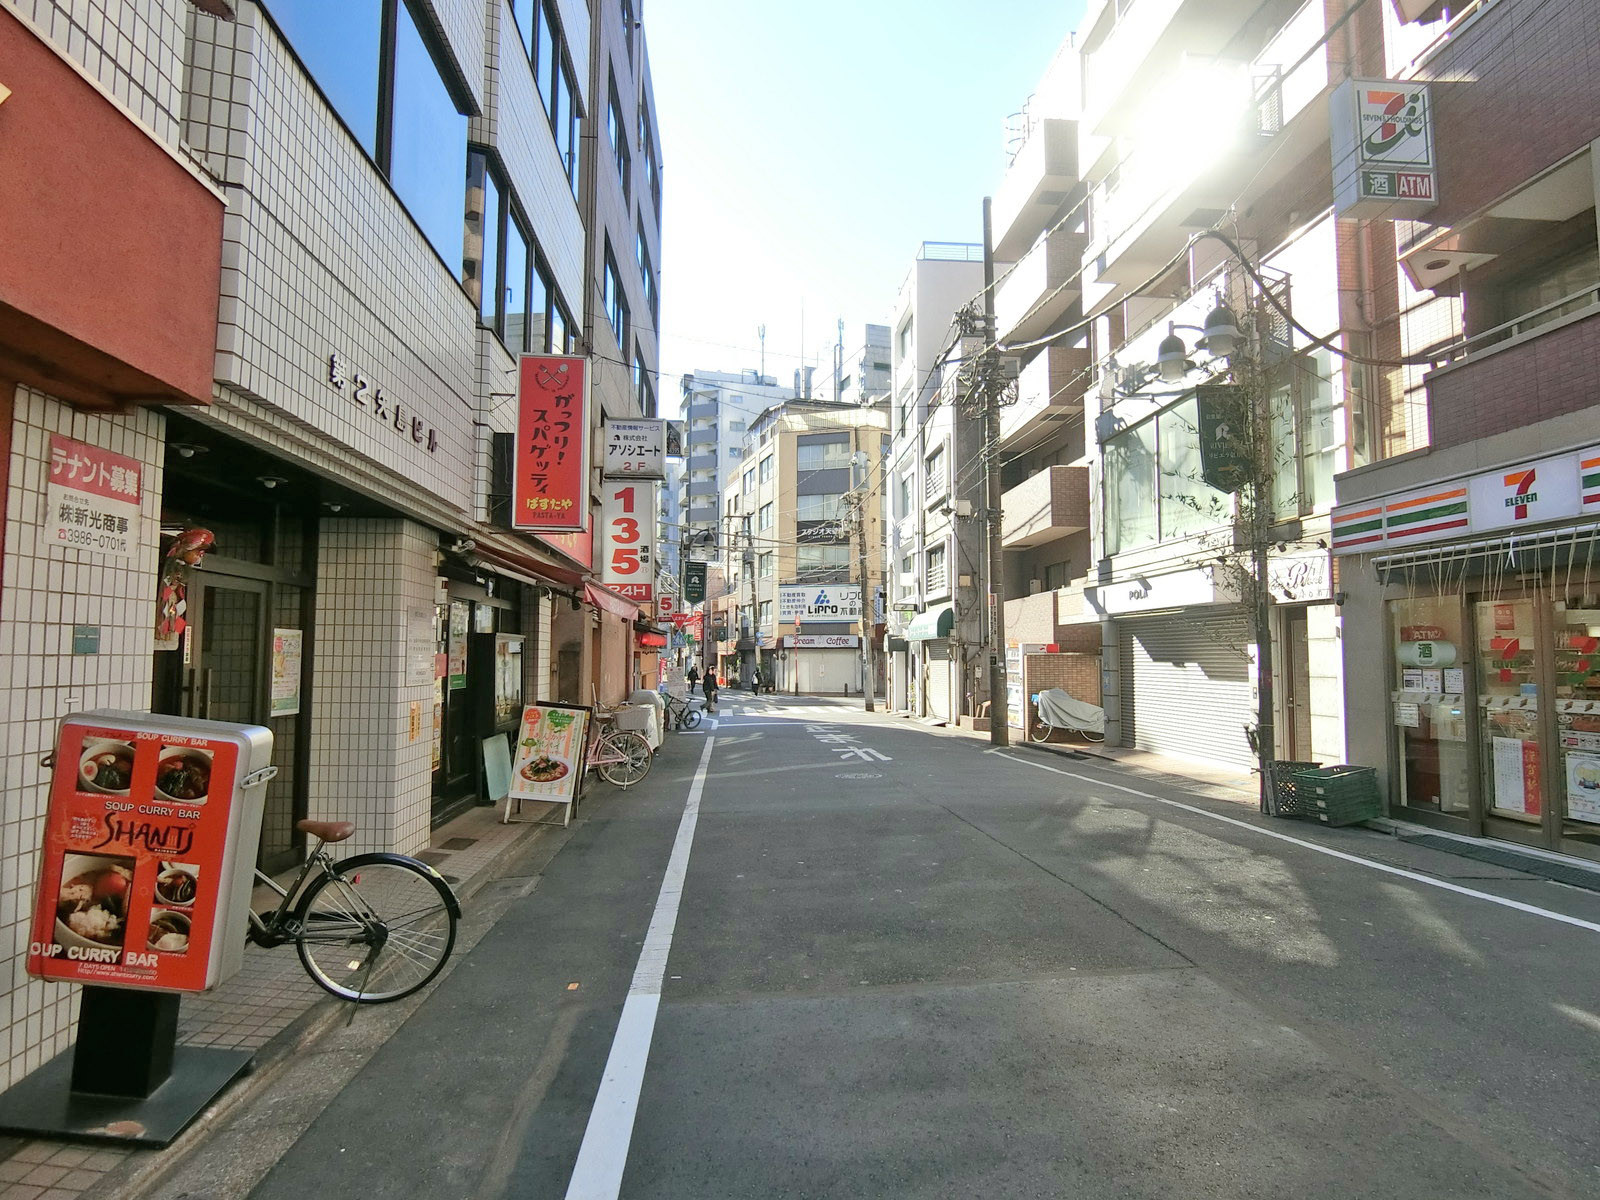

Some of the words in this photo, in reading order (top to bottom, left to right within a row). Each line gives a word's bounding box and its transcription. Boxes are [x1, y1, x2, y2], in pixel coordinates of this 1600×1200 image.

[1370, 174, 1389, 195] 酒
[1399, 175, 1430, 197] ATM
[611, 424, 661, 432] 不動産情報サービス
[623, 434, 648, 442] 株式会社
[529, 409, 552, 494] スパゲッティ
[608, 444, 661, 457] アソシエート
[51, 447, 138, 497] テナント募集
[532, 511, 566, 520] PASTA-YA
[640, 545, 650, 563] 酒場
[1129, 589, 1148, 600] POLA
[660, 597, 672, 611] 5
[826, 636, 850, 646] Coffee
[1418, 643, 1433, 658] 酒
[136, 732, 159, 741] SOUP
[161, 734, 188, 744] CURRY
[190, 738, 208, 747] BAR
[803, 724, 894, 762] 止まれ
[105, 801, 135, 812] SOUP
[138, 804, 174, 816] CURRY
[178, 809, 201, 820] BAR
[67, 945, 121, 964] CURRY
[126, 951, 159, 968] BAR
